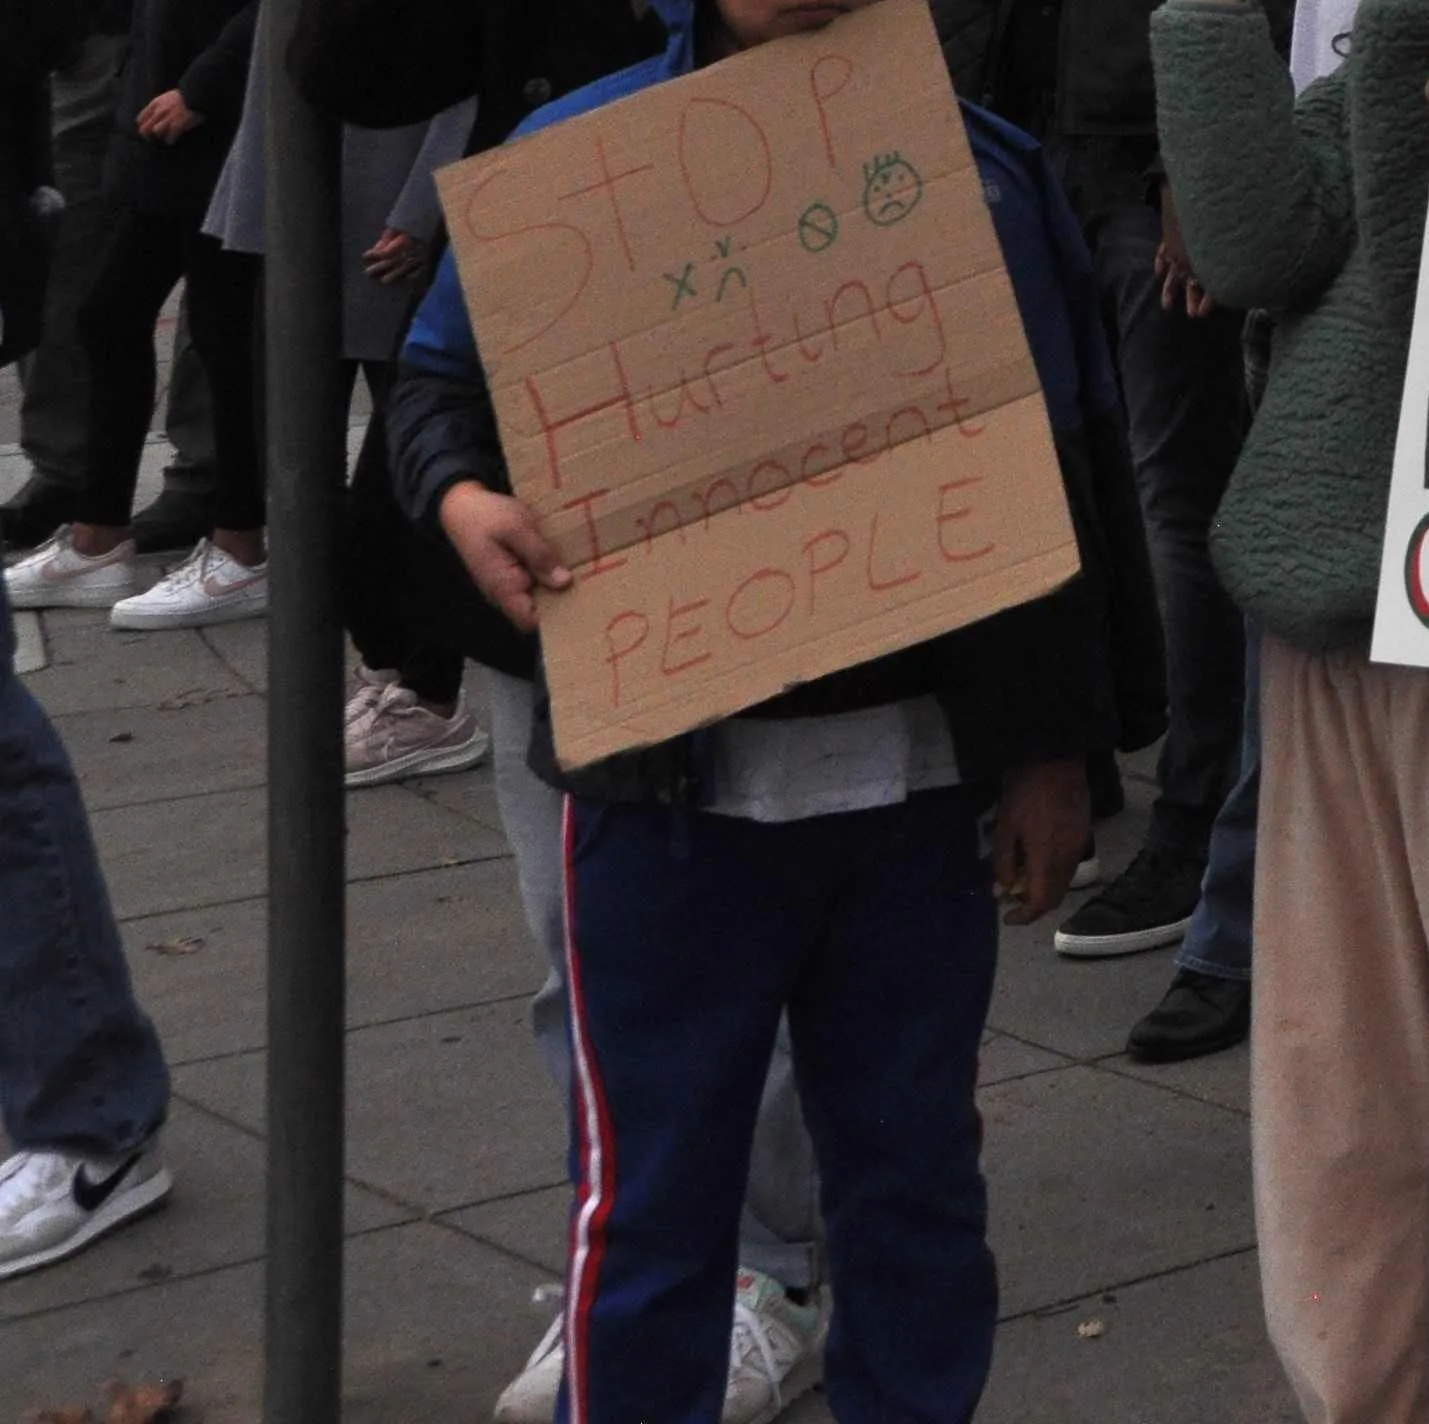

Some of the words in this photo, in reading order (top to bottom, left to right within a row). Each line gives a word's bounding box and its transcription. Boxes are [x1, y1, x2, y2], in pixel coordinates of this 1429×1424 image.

[463, 54, 855, 355] STOP
[522, 256, 952, 491] Hurting
[556, 366, 989, 584] Innocent
[602, 475, 997, 709] PEOPLE
